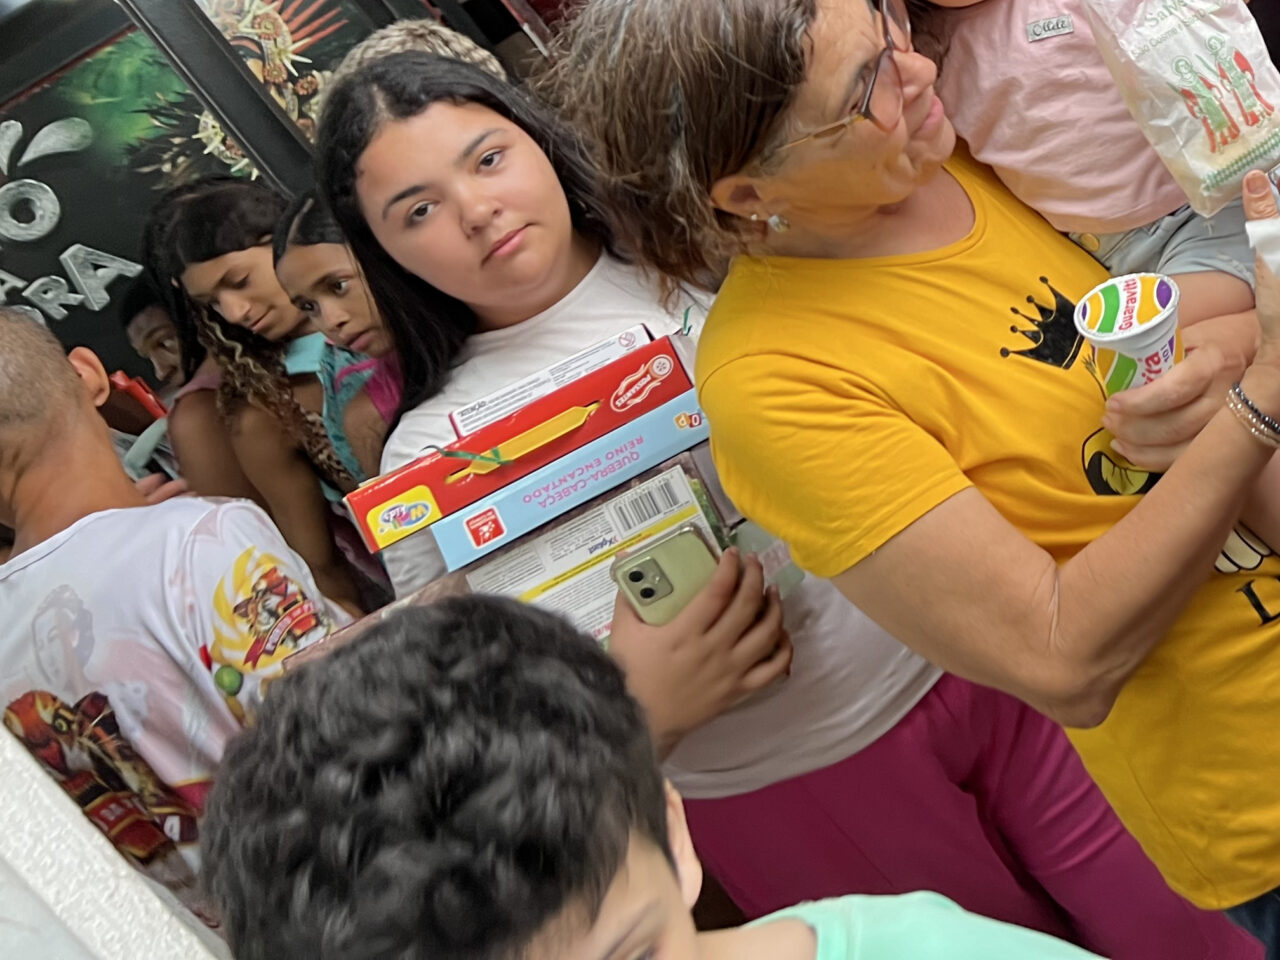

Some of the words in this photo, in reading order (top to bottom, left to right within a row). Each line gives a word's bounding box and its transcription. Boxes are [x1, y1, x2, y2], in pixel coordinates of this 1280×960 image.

[605, 435, 644, 460] REINO
[522, 457, 602, 504] ENCANTADO
[537, 450, 641, 509] QUEBRA-CABEÇA
